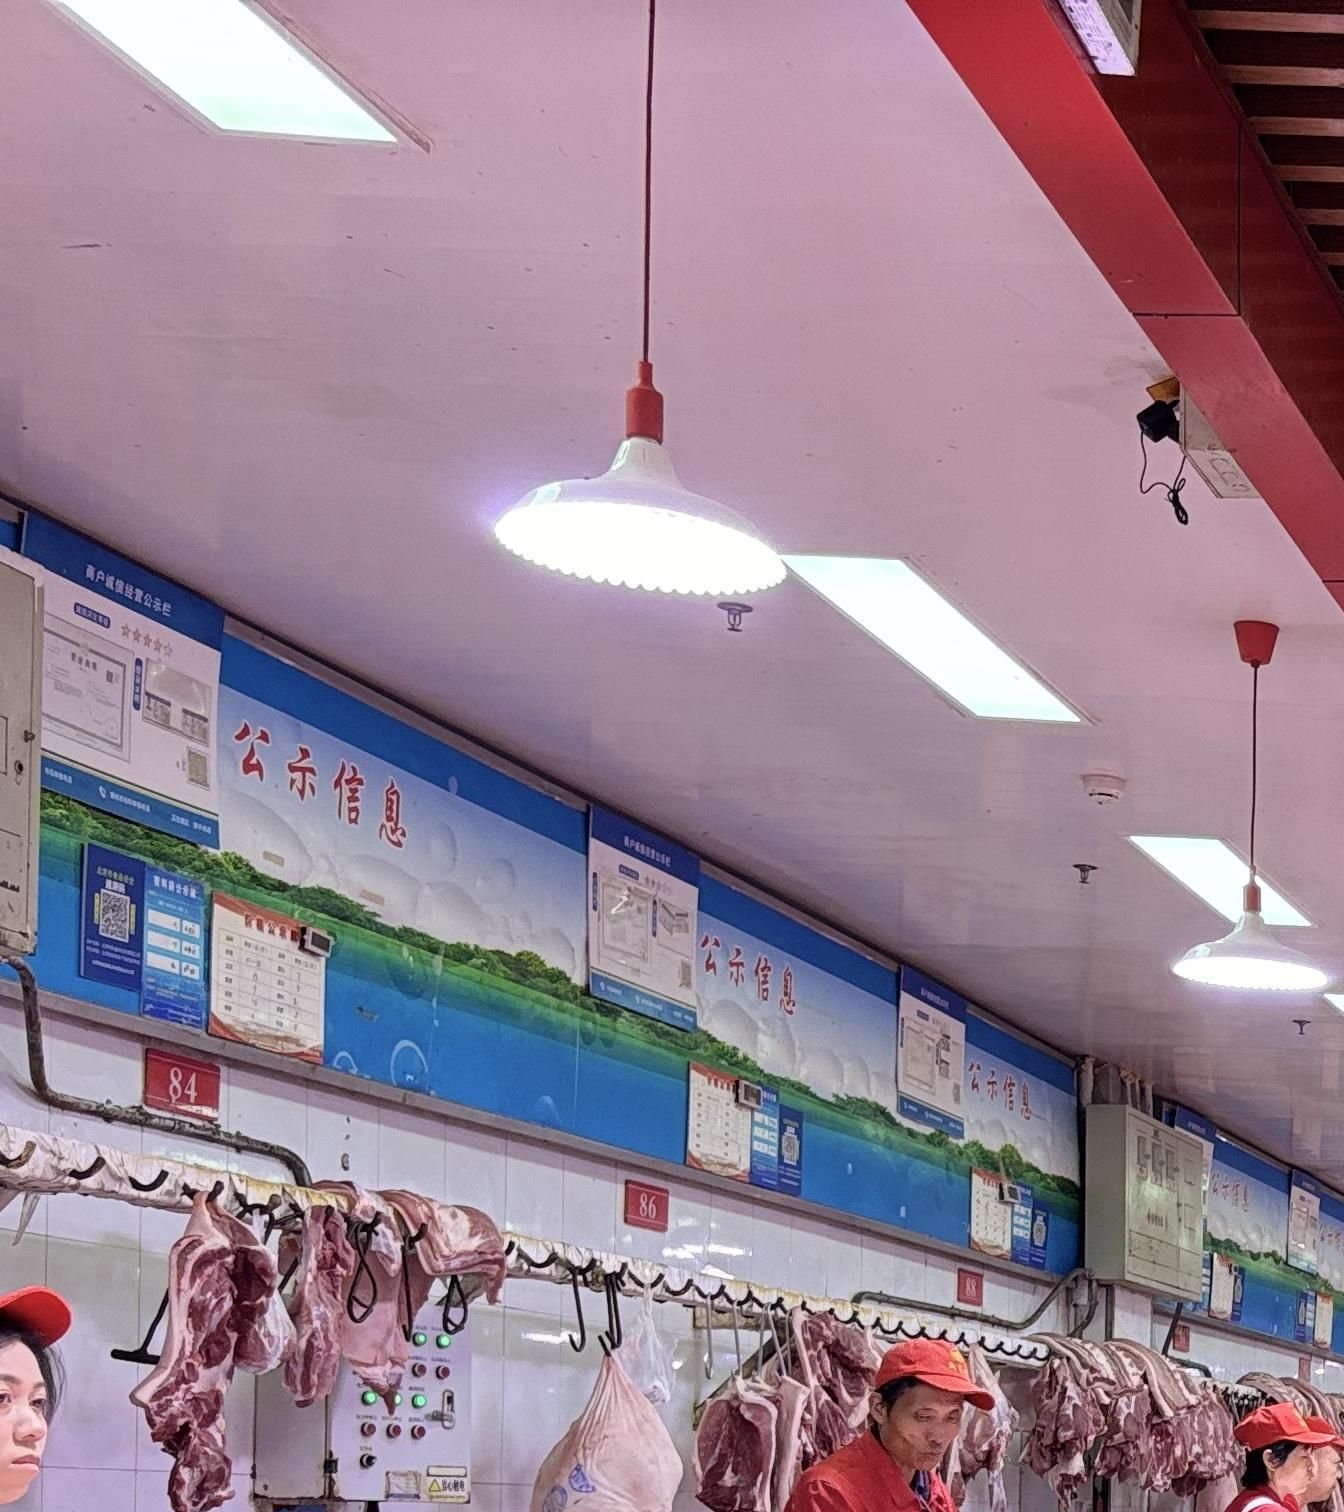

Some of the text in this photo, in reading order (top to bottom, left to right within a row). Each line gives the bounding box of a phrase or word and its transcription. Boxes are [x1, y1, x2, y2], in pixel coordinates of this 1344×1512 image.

[233, 719, 408, 849] 公示信息
[700, 934, 796, 1017] 公示信息
[168, 1065, 199, 1102] 84
[968, 1060, 1032, 1121] 公示信息
[638, 1193, 658, 1220] 86
